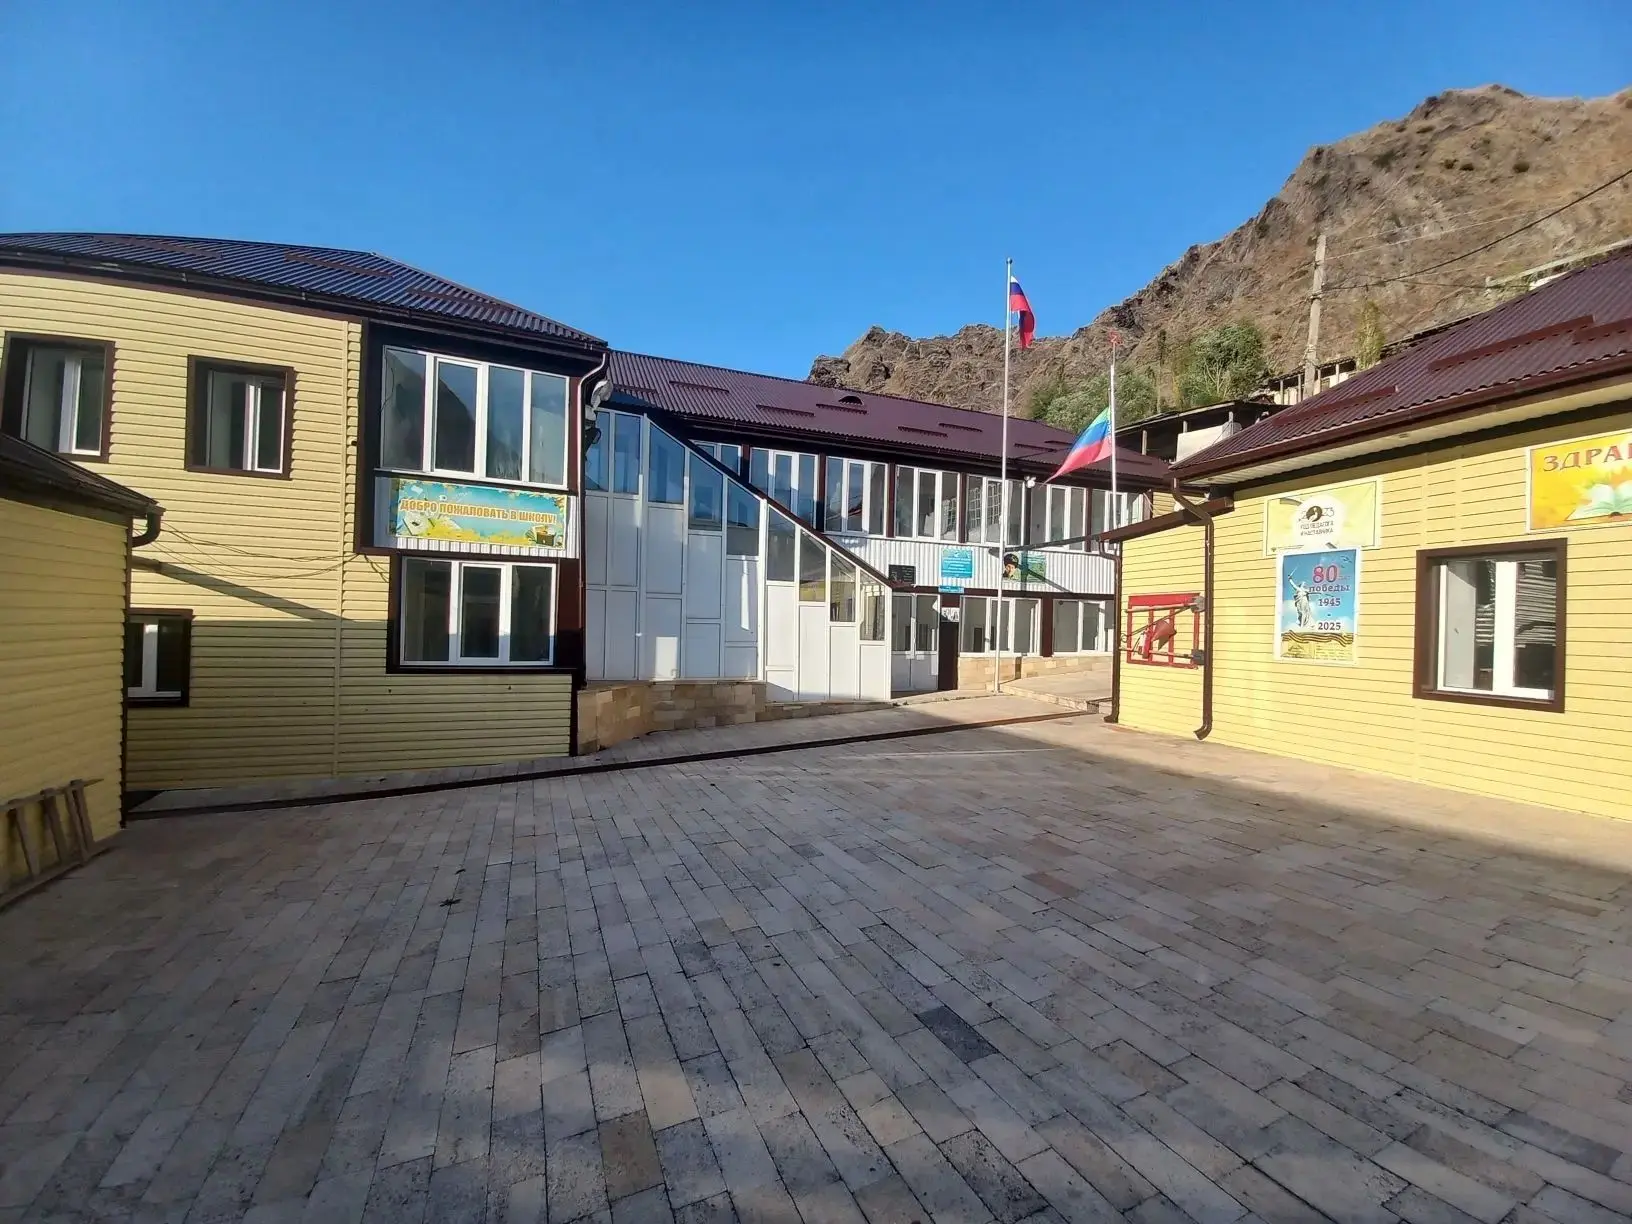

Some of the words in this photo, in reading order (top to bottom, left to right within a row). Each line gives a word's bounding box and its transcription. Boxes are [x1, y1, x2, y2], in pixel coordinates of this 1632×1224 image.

[400, 499, 437, 512] ДОБРО
[439, 503, 509, 519] ПОЖАЛОВАТЬ
[510, 510, 518, 520] В
[519, 512, 557, 524] ШКОЛУ!
[1312, 564, 1339, 584] 80
[1309, 584, 1351, 593] победы
[1318, 598, 1341, 607] 1945
[1317, 622, 1342, 631] 2025
